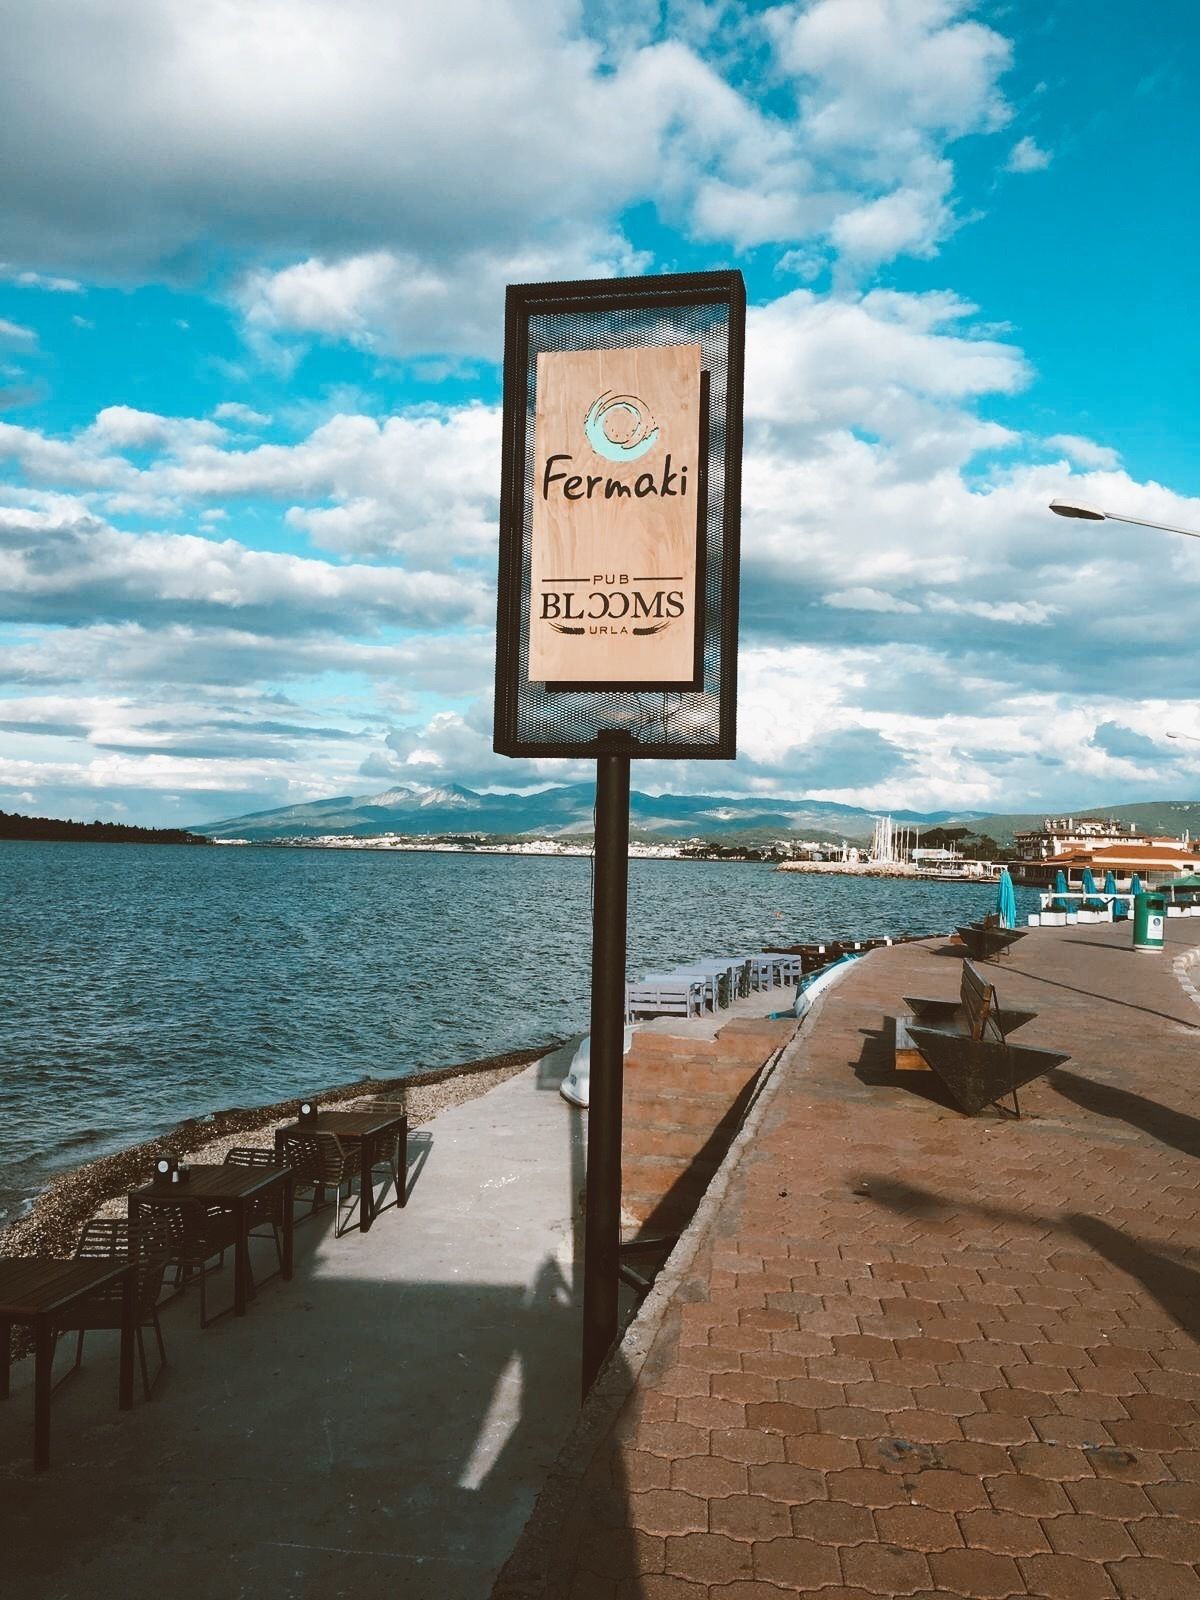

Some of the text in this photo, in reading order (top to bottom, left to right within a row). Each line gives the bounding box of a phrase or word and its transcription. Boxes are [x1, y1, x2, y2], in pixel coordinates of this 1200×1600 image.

[543, 454, 688, 500] Fermaki
[593, 574, 629, 585] PUB
[589, 626, 628, 635] URLA
